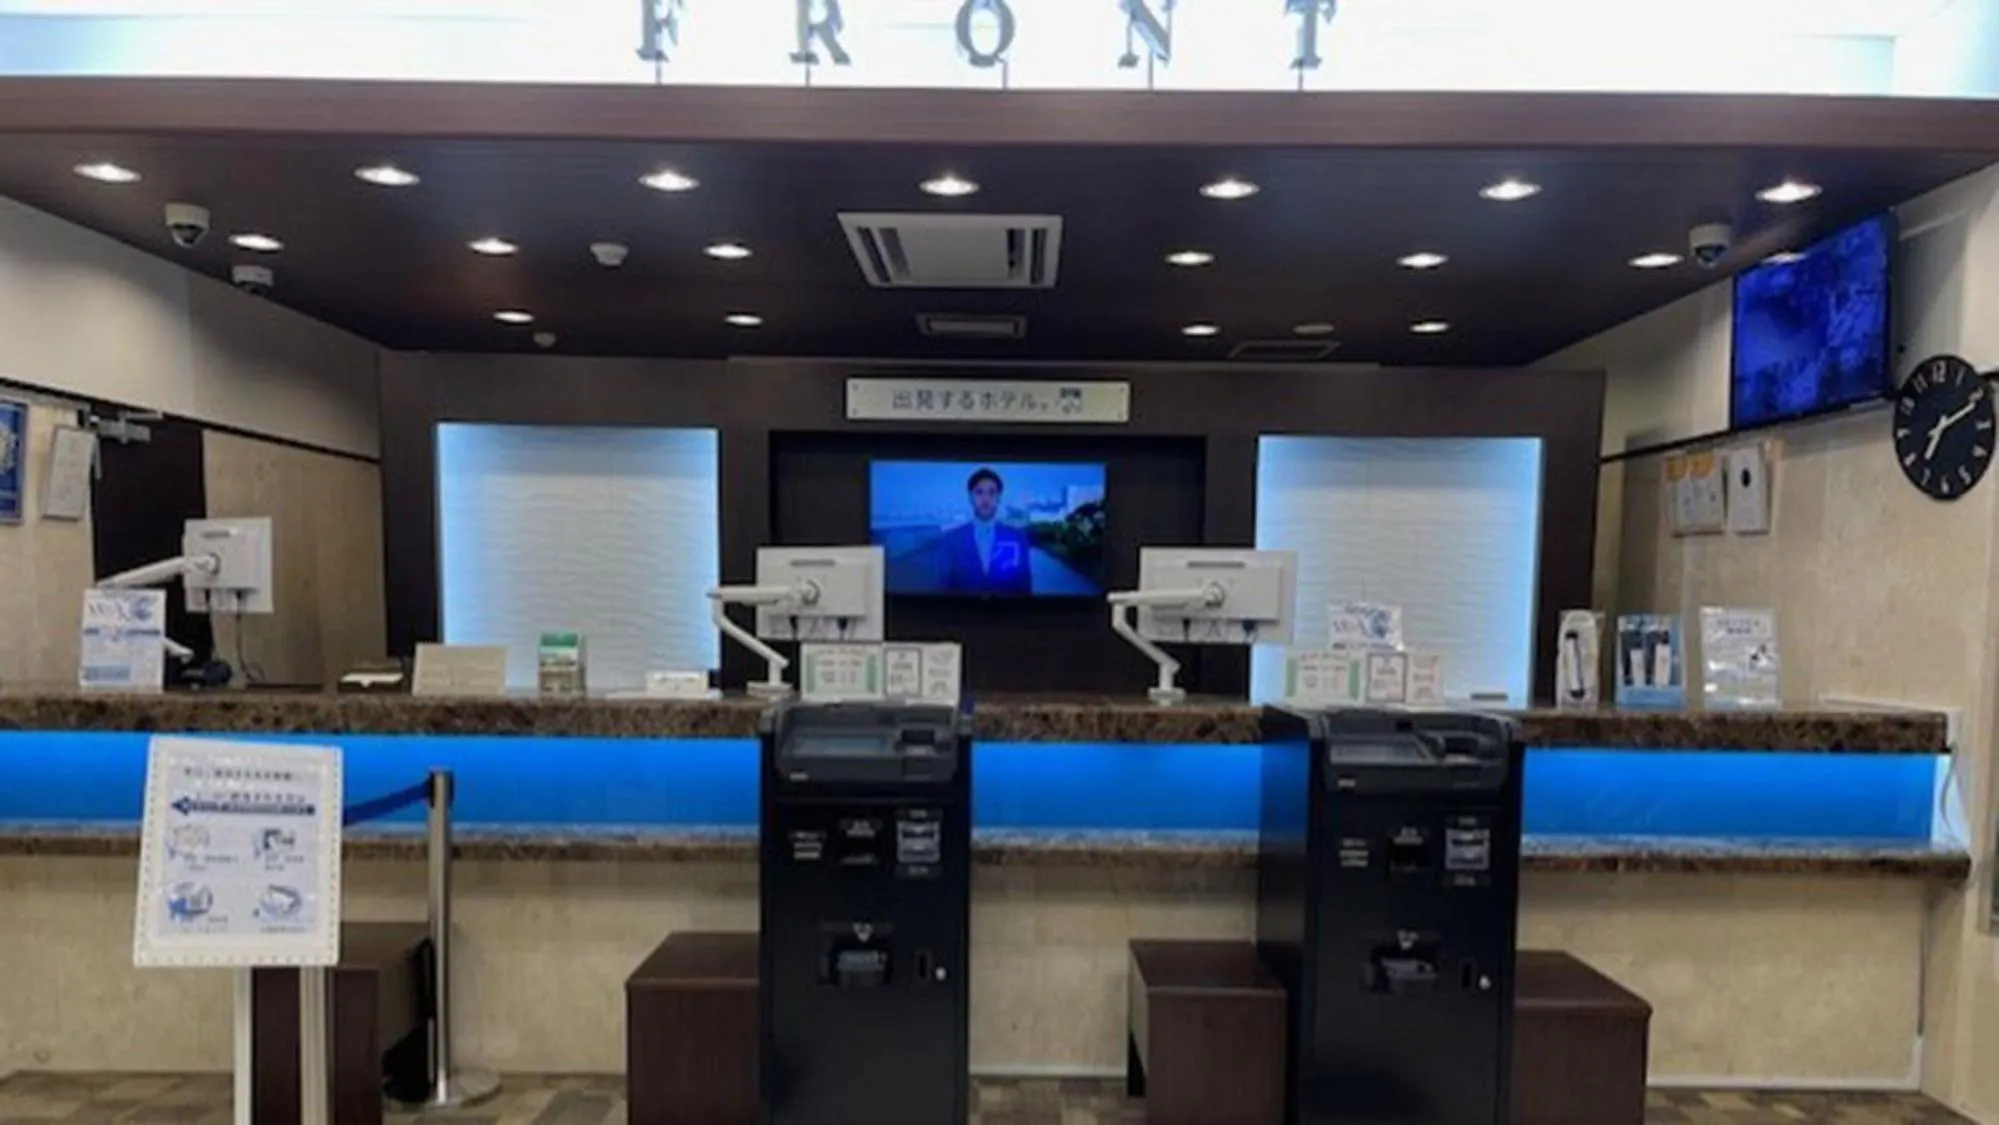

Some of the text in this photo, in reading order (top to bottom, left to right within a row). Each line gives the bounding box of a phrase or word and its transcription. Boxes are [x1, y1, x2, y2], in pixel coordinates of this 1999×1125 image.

[636, 0, 1336, 68] FRONT
[1932, 360, 1947, 383] 12
[1955, 367, 1965, 386] 1
[1913, 373, 1928, 394] 11
